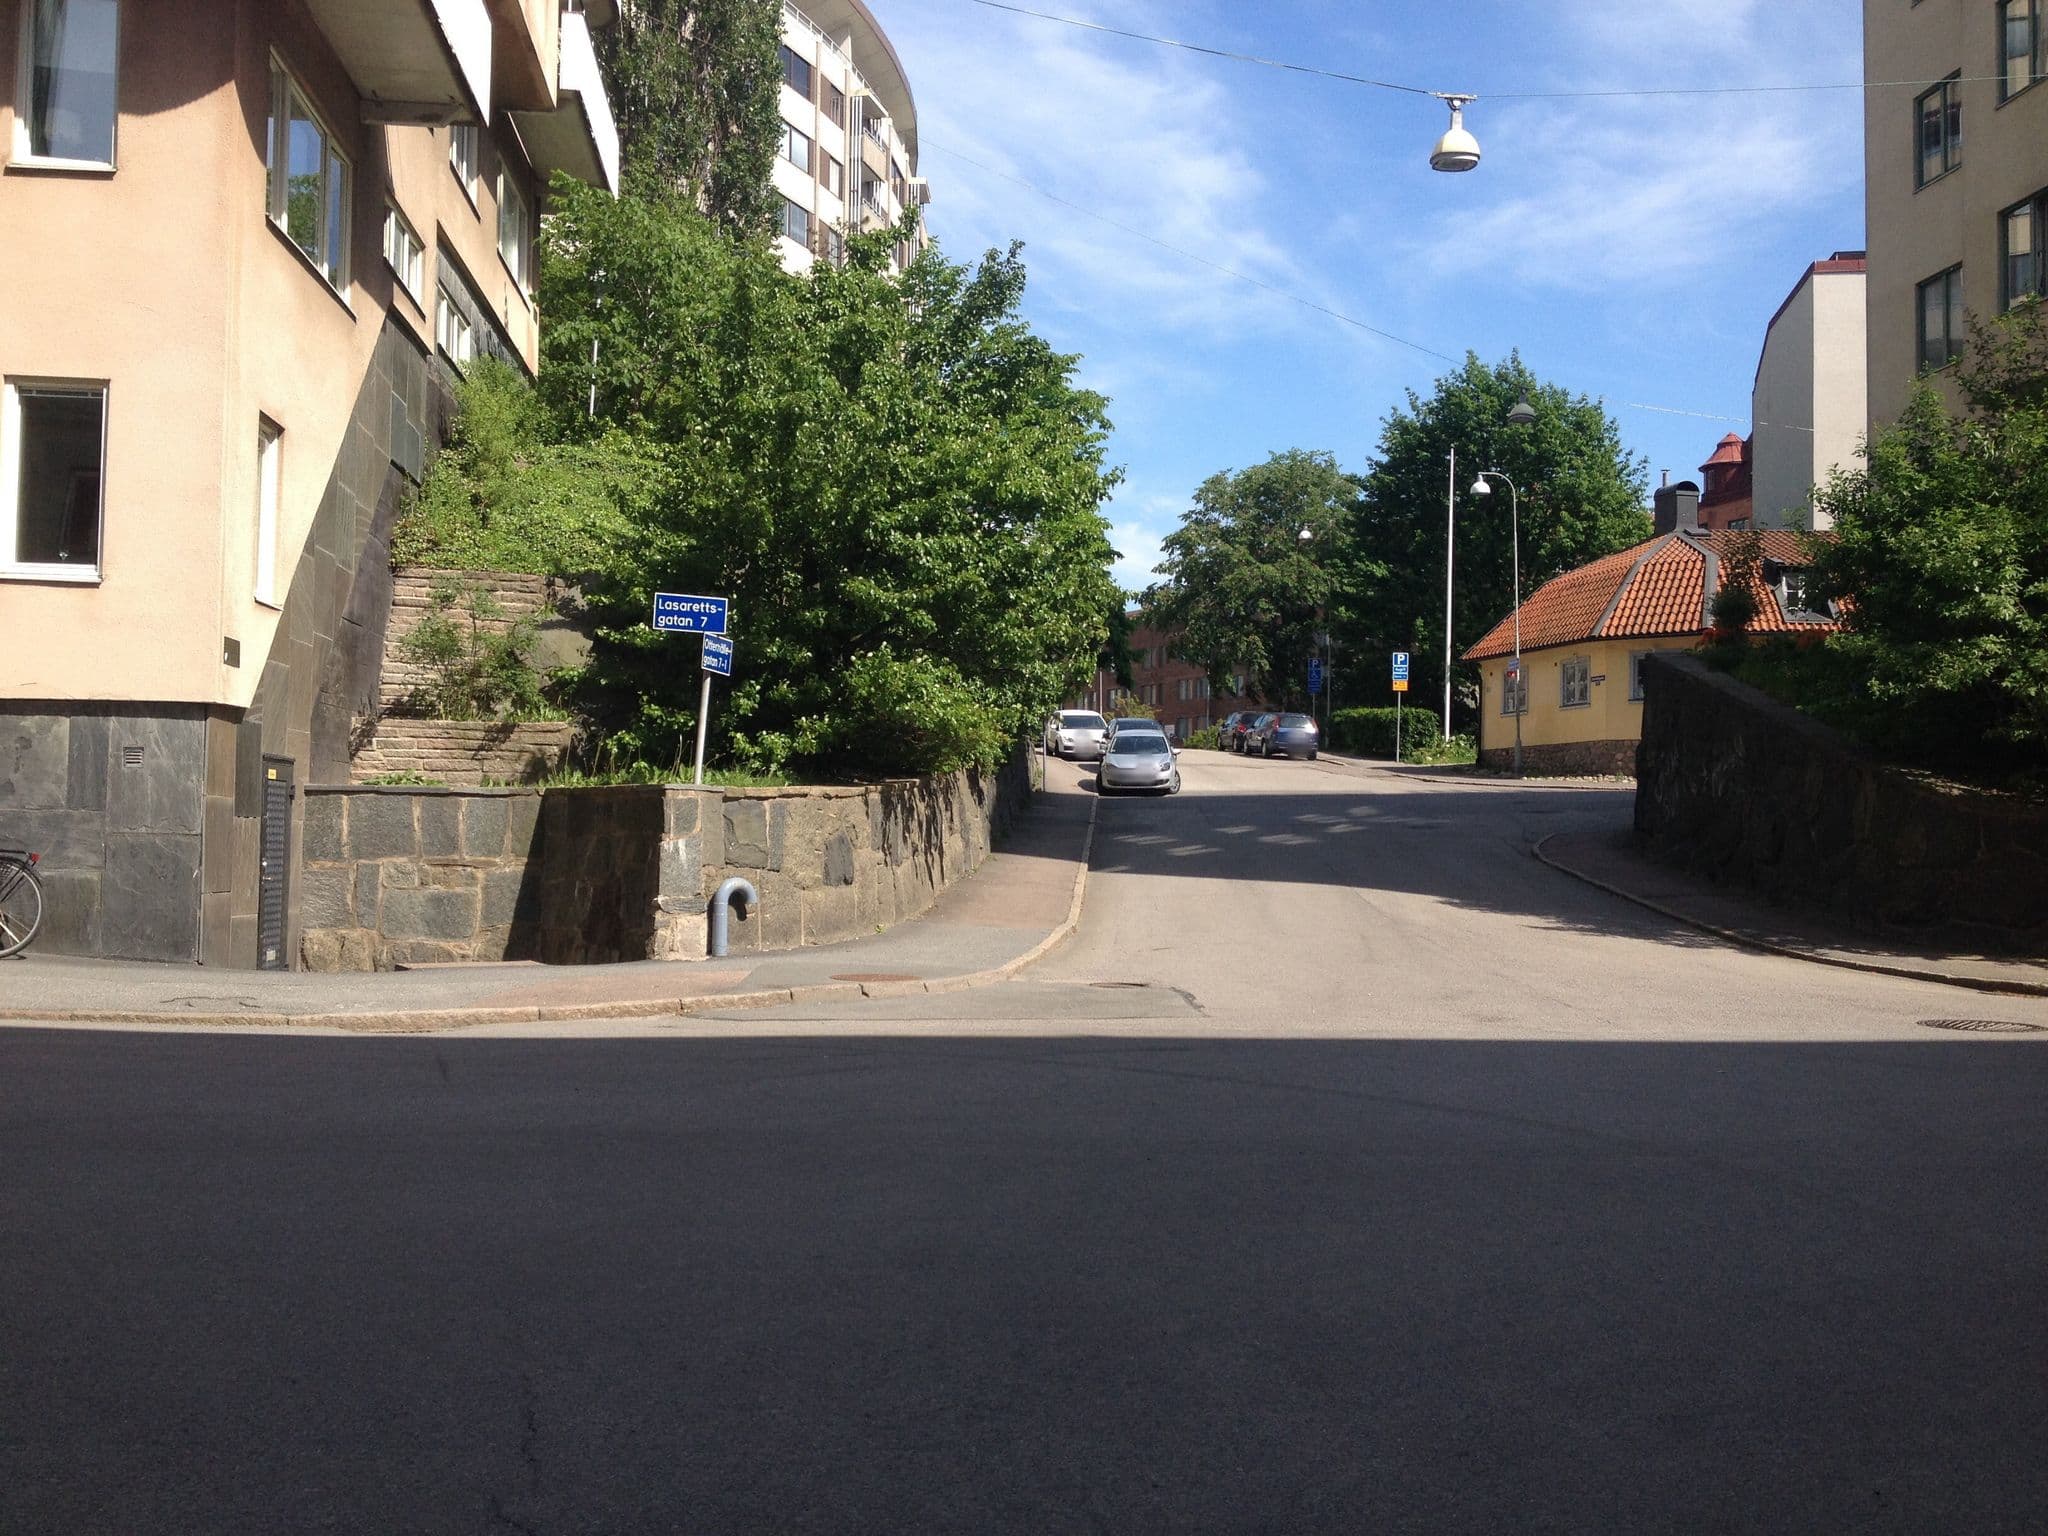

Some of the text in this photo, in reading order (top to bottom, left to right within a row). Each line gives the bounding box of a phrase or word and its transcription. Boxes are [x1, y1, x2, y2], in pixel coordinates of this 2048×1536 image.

[658, 598, 723, 613] Lasaretts-
[657, 615, 708, 628] gatan 7
[703, 655, 718, 667] gatan
[1312, 659, 1319, 668] P
[1397, 654, 1405, 664] P
